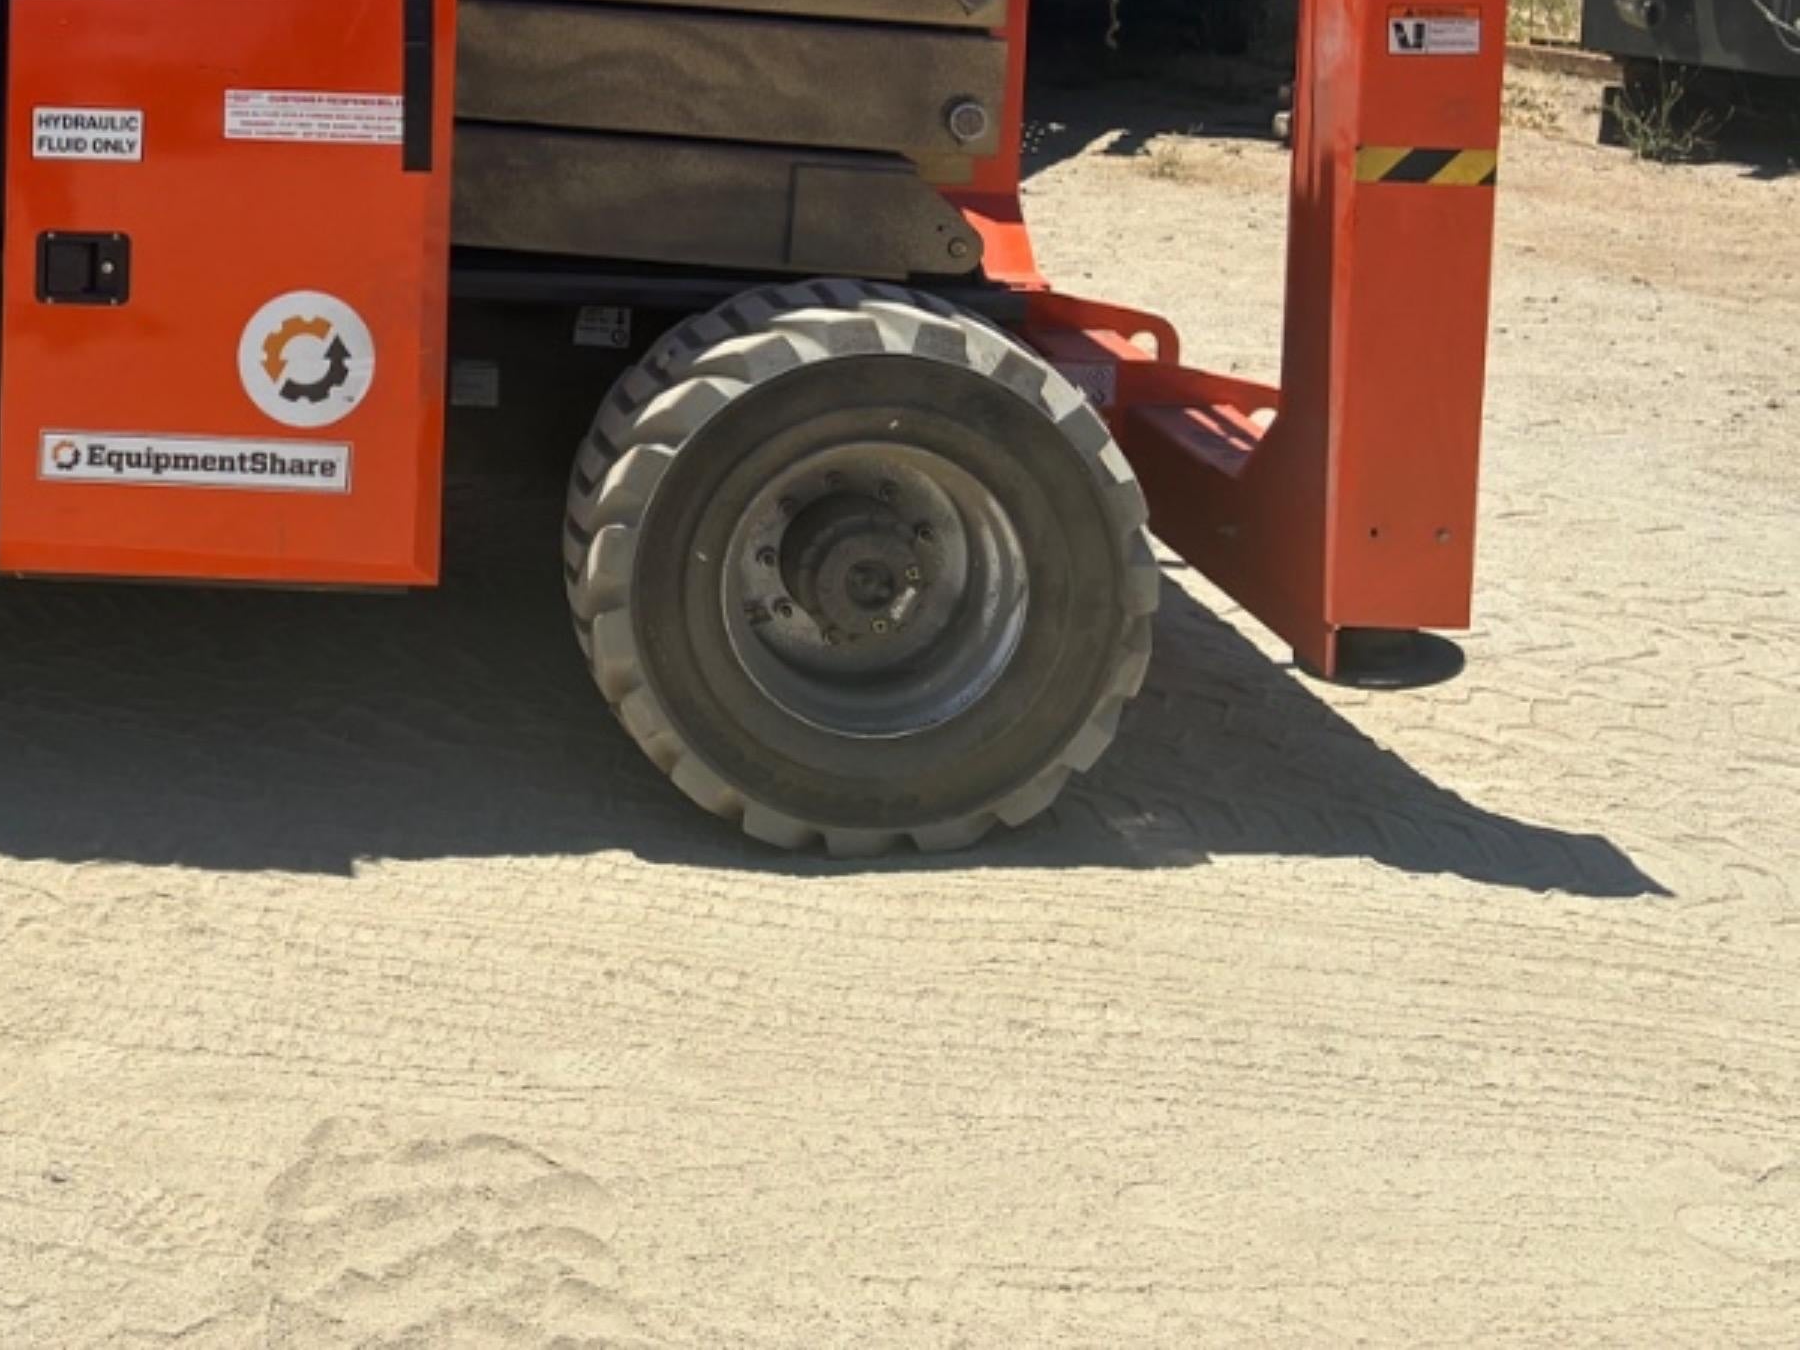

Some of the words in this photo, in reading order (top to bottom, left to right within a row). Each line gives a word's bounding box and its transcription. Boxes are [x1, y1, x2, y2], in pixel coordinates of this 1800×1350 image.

[37, 113, 139, 131] HYDRAULIC
[37, 135, 88, 152] FLUID
[92, 138, 137, 154] ONLY
[86, 444, 338, 478] EquipmentShare
